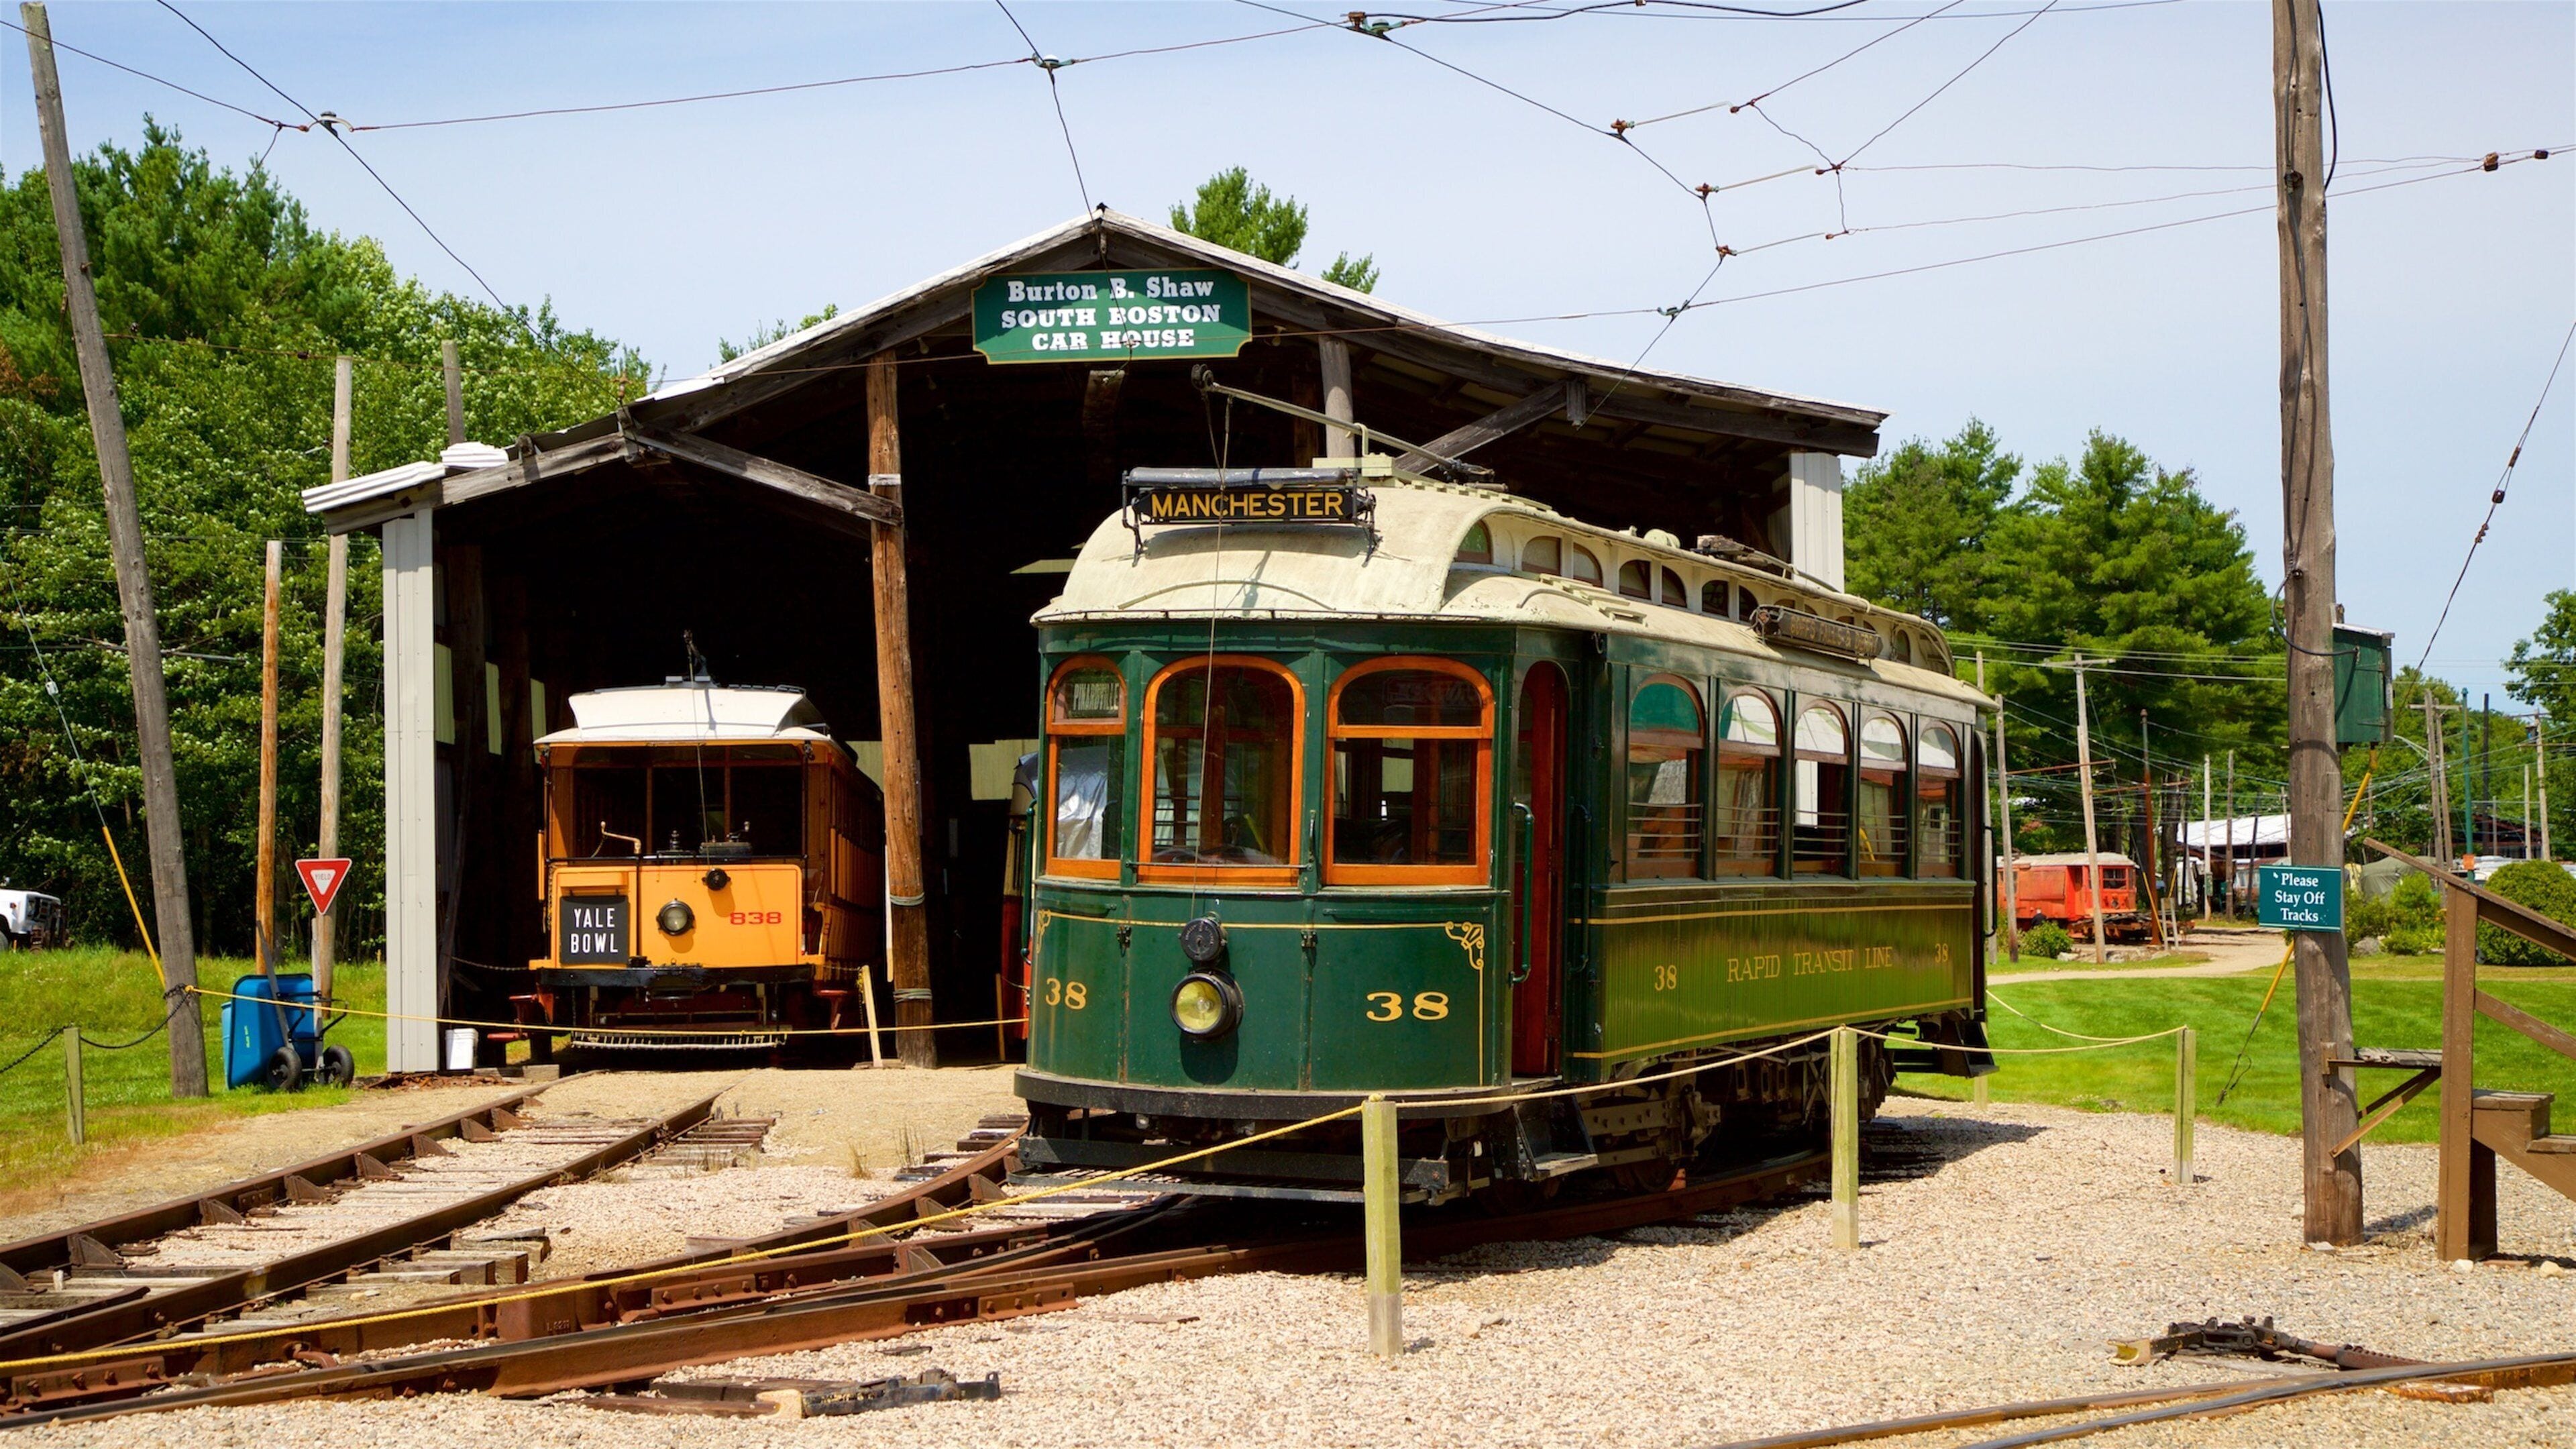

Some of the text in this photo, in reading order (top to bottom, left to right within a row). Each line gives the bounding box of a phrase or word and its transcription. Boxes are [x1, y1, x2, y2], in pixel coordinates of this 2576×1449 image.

[1008, 276, 1214, 303] Burton B. Shaw
[1002, 304, 1220, 329] SOUTH BOSTON
[1032, 329, 1194, 351] CAR HOUSE
[1151, 492, 1344, 517] MANCHESTER
[2282, 873, 2319, 887] Please
[2275, 890, 2325, 907] Stay Off
[574, 908, 615, 928] YALE
[730, 912, 782, 925] 838
[2280, 908, 2319, 922] Tracks
[570, 933, 619, 955] BOWL
[1935, 943, 1949, 963] 38
[1727, 946, 1893, 983] RAPID TRANSIT LINE
[1654, 965, 1677, 991] 38
[1045, 978, 1087, 1010] 38
[1366, 991, 1449, 1021] 38
